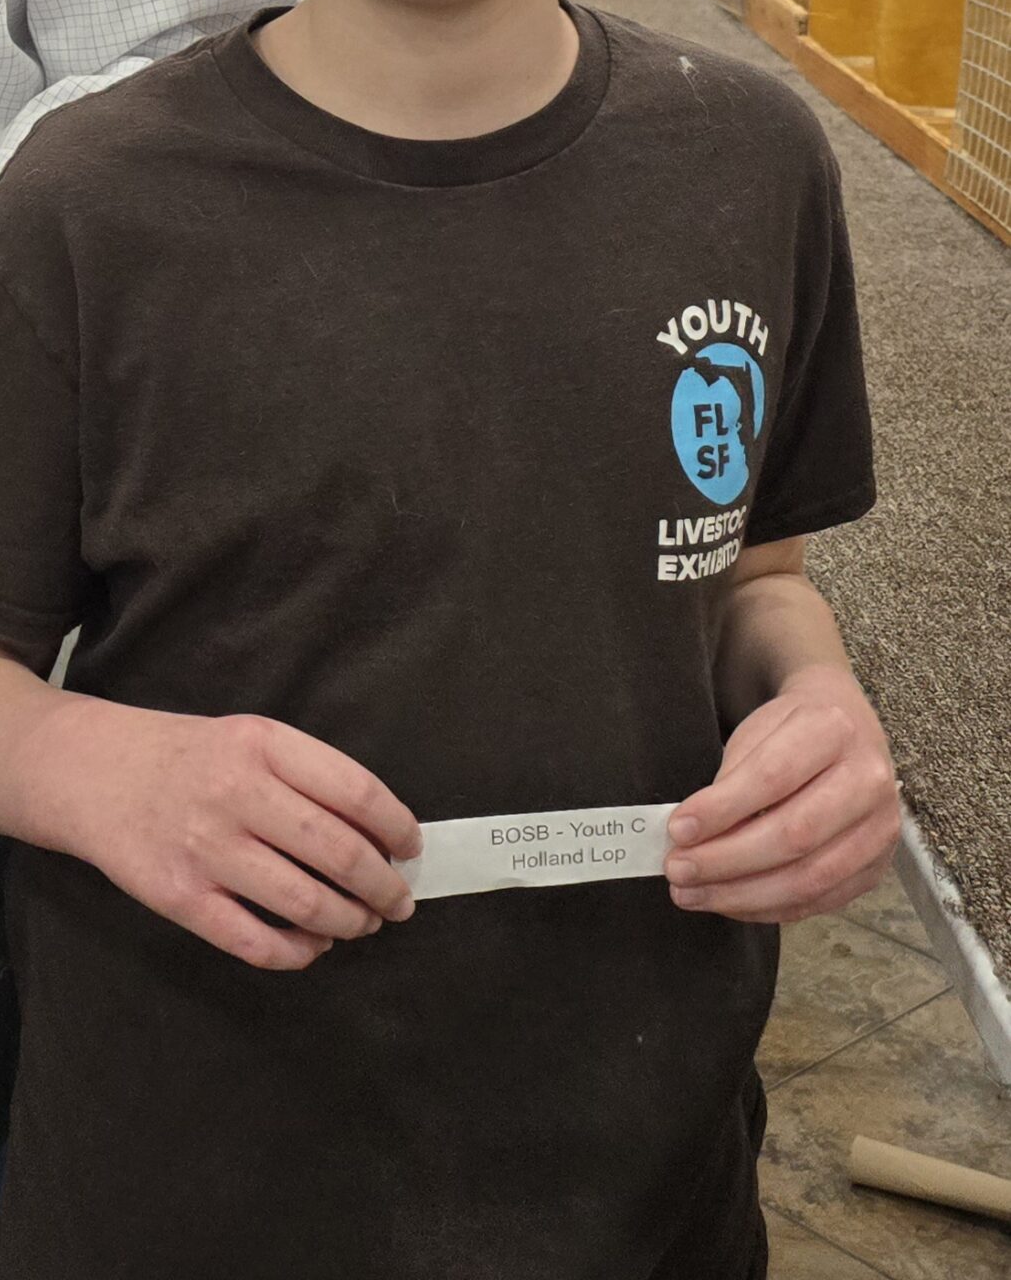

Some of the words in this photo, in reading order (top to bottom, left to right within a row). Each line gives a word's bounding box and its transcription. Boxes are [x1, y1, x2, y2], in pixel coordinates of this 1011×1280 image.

[656, 298, 769, 357] YOUTH
[693, 403, 729, 438] FL
[696, 443, 730, 480] SF
[658, 505, 747, 546] LIVESTOC
[657, 537, 743, 582] EXHIBITO
[491, 824, 550, 846] BOSB
[570, 819, 625, 839] Youth
[631, 817, 646, 834] C
[512, 849, 584, 870] Holland
[591, 847, 627, 864] Lop
